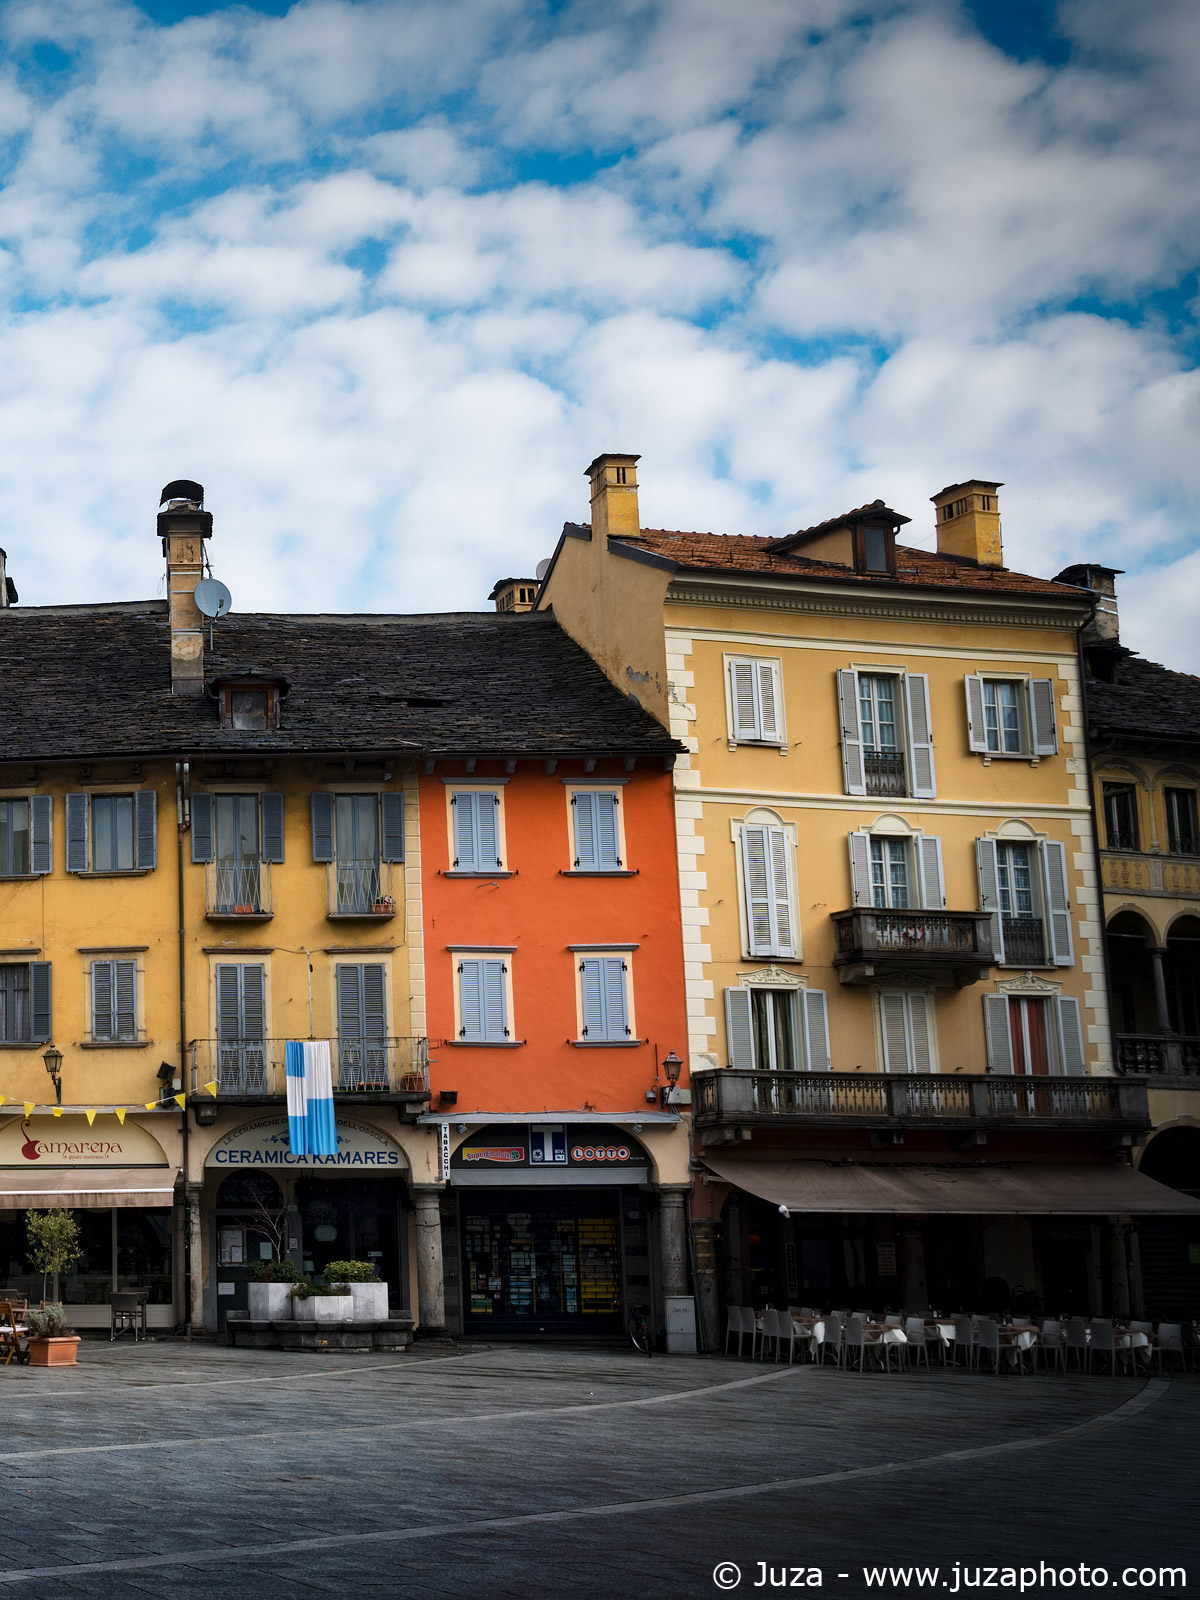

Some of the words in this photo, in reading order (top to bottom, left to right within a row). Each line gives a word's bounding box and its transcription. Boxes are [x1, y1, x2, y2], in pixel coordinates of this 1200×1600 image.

[223, 1136, 233, 1146] LE
[233, 1118, 281, 1137] CERAMICHE
[337, 1119, 388, 1147] DELL'OSSOLA
[215, 1150, 308, 1164] CERAMICA
[313, 1151, 399, 1165] KAMARES
[573, 1148, 628, 1160] LOTTO
